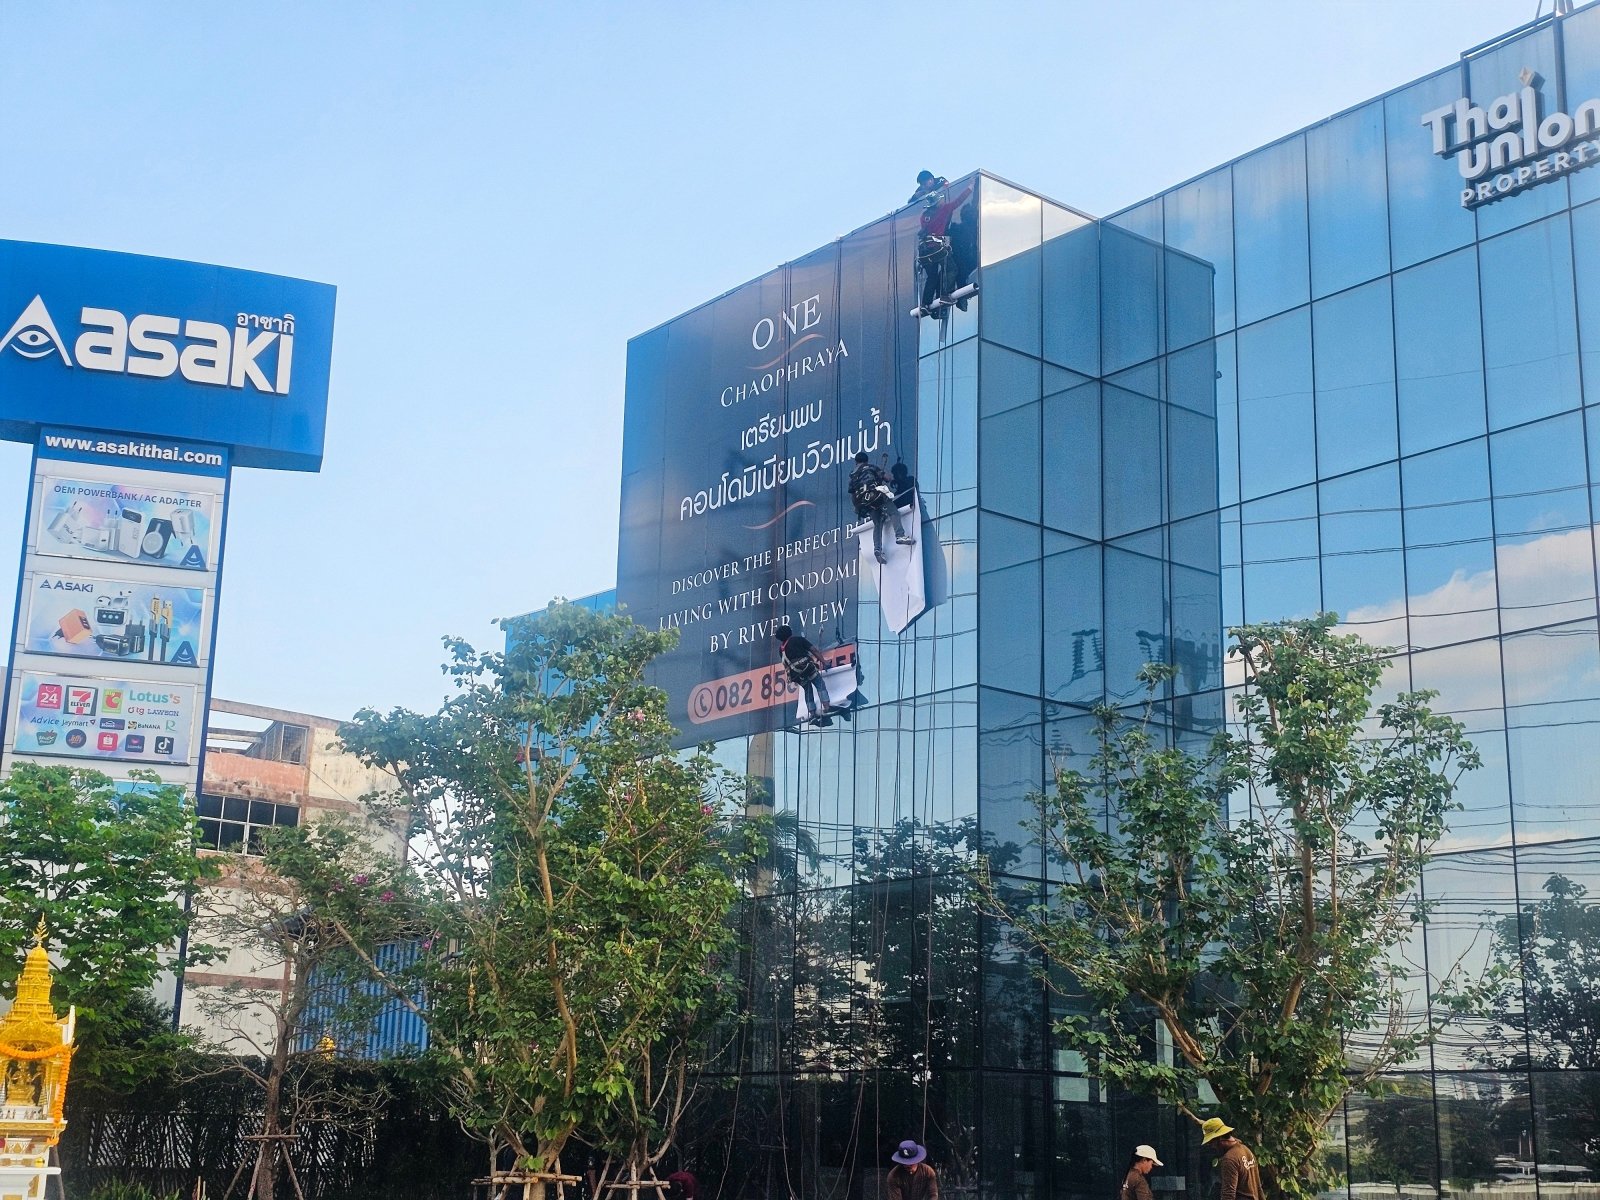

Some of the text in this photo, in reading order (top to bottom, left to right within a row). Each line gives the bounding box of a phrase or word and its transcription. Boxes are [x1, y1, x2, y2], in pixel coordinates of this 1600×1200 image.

[1421, 66, 1538, 155] Thai
[237, 312, 295, 333] อาซากิ
[752, 294, 822, 350] ONE
[75, 306, 294, 395] asaki
[720, 338, 849, 407] CHAOPHRAYA
[45, 434, 222, 466] www.asakithai.com
[741, 400, 823, 450] เตรียมพบ
[680, 407, 891, 521] คอนโดมิเนียมวิวแม่น้ำ
[54, 485, 76, 494] OEM
[78, 487, 138, 501] POWERBANK
[144, 495, 158, 503] AC
[160, 496, 202, 508] ADAPTER
[672, 561, 740, 595] DISCOVER
[743, 550, 772, 572] THE
[777, 527, 841, 562] PERFECT
[659, 558, 858, 630] LIVING WITH CONDOMI
[709, 630, 734, 653] BY
[798, 598, 849, 628] VIEW
[30, 716, 60, 725] Advice
[40, 692, 58, 704] 24
[129, 690, 181, 704] Lotus's
[715, 679, 753, 716] 082
